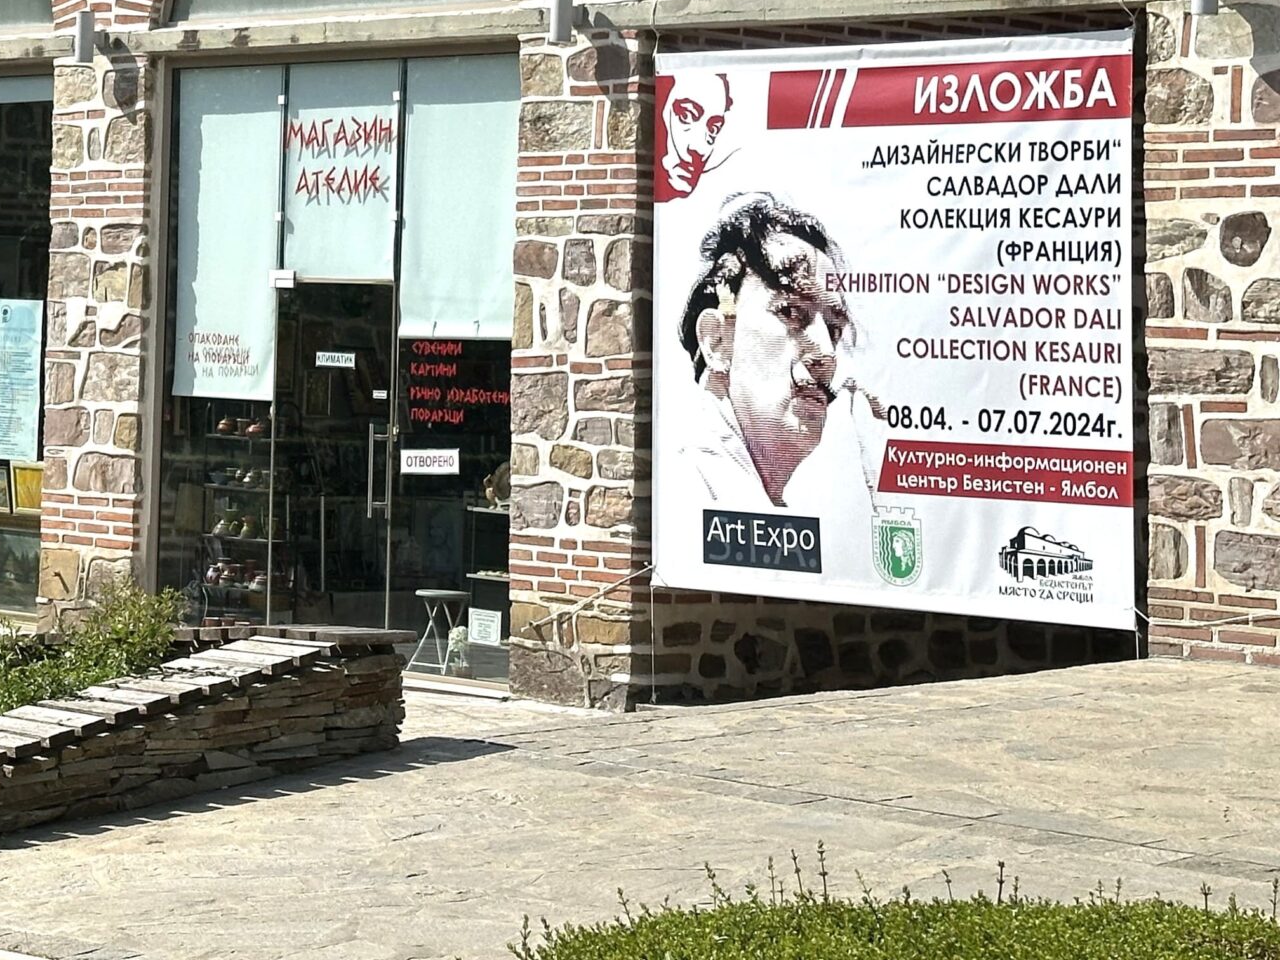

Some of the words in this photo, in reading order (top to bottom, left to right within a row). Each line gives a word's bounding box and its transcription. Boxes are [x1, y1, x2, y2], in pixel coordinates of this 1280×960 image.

[914, 67, 1117, 114] ИЗЛОЖБА
[286, 114, 393, 149] МАГАЗИН
[862, 139, 1020, 169] „ДИЗАЙНЕРСКИ
[295, 163, 381, 196] АТЕЛИЕ
[927, 174, 1049, 198] САЛВАДОР
[1055, 173, 1121, 198] ДАЛИ
[900, 208, 1011, 231] КОЛЕКЦИЯ
[1019, 207, 1121, 228] КЕСАУРИ
[996, 239, 1122, 268] (ФРАНЦИЯ)
[825, 272, 930, 294] EXHIBITION
[938, 274, 1025, 295] “DESIGN
[1033, 274, 1121, 296] WORKS”
[949, 306, 1066, 329] SALVADOR
[1074, 308, 1121, 330] DALI
[188, 352, 200, 363] НА
[896, 337, 1026, 361] COLLECTION
[1035, 341, 1121, 364] KESAURI
[410, 362, 457, 377] КАРТИНИ
[1019, 373, 1122, 404] (FRANCE)
[410, 407, 464, 424] ПОДАРЪЦИ
[887, 405, 953, 431] 08.04.
[978, 409, 1123, 439] 07.07.2024г.
[406, 455, 455, 468] ОТВОРЕНО
[887, 446, 1127, 476] Културно-информационен
[896, 473, 958, 493] център
[963, 475, 1045, 495] Безистен
[1061, 480, 1119, 500] Ямбол
[707, 516, 746, 545] Art
[753, 519, 815, 556] Expo
